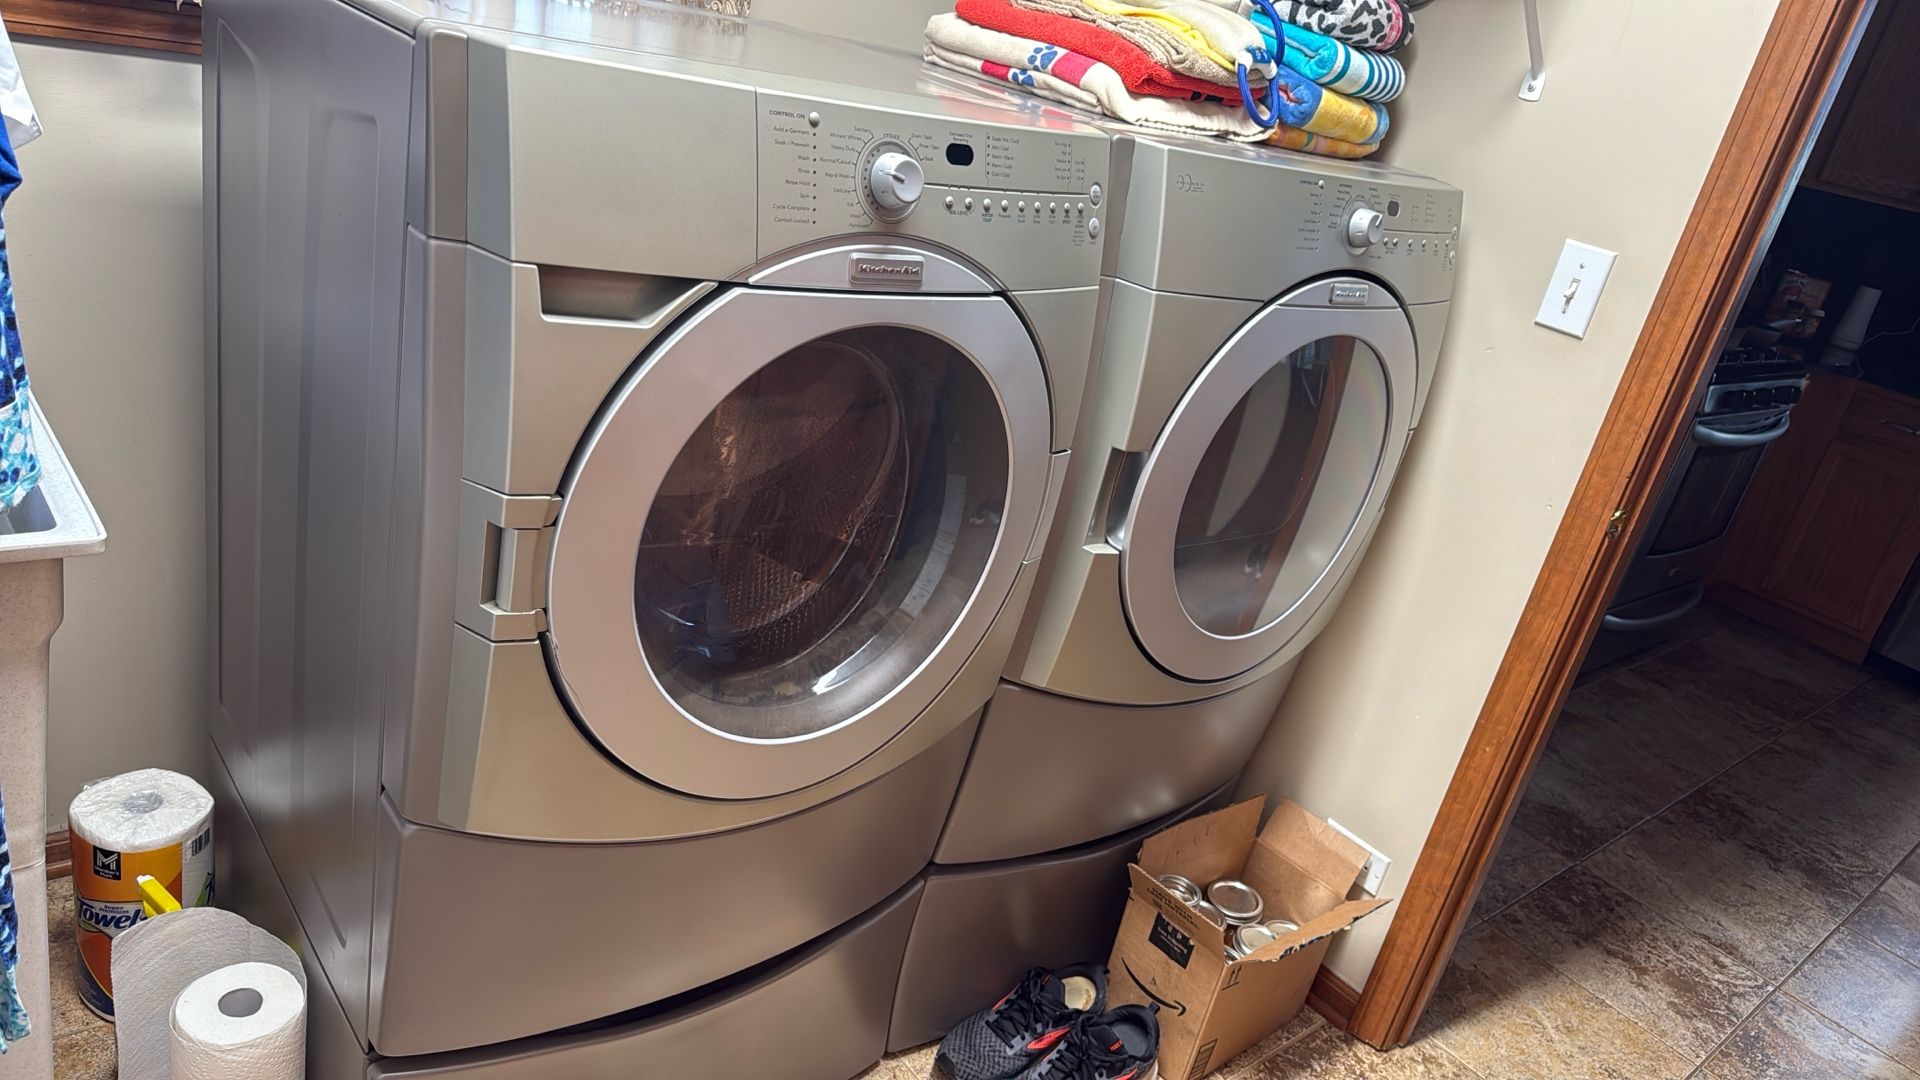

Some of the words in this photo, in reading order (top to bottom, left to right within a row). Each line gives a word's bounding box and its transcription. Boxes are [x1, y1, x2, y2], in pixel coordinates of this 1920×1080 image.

[769, 109, 795, 119] CONTROL
[789, 127, 810, 135] Garment
[845, 145, 856, 153] Duty
[772, 203, 786, 211] Cycle
[858, 263, 921, 275] KitchenAid
